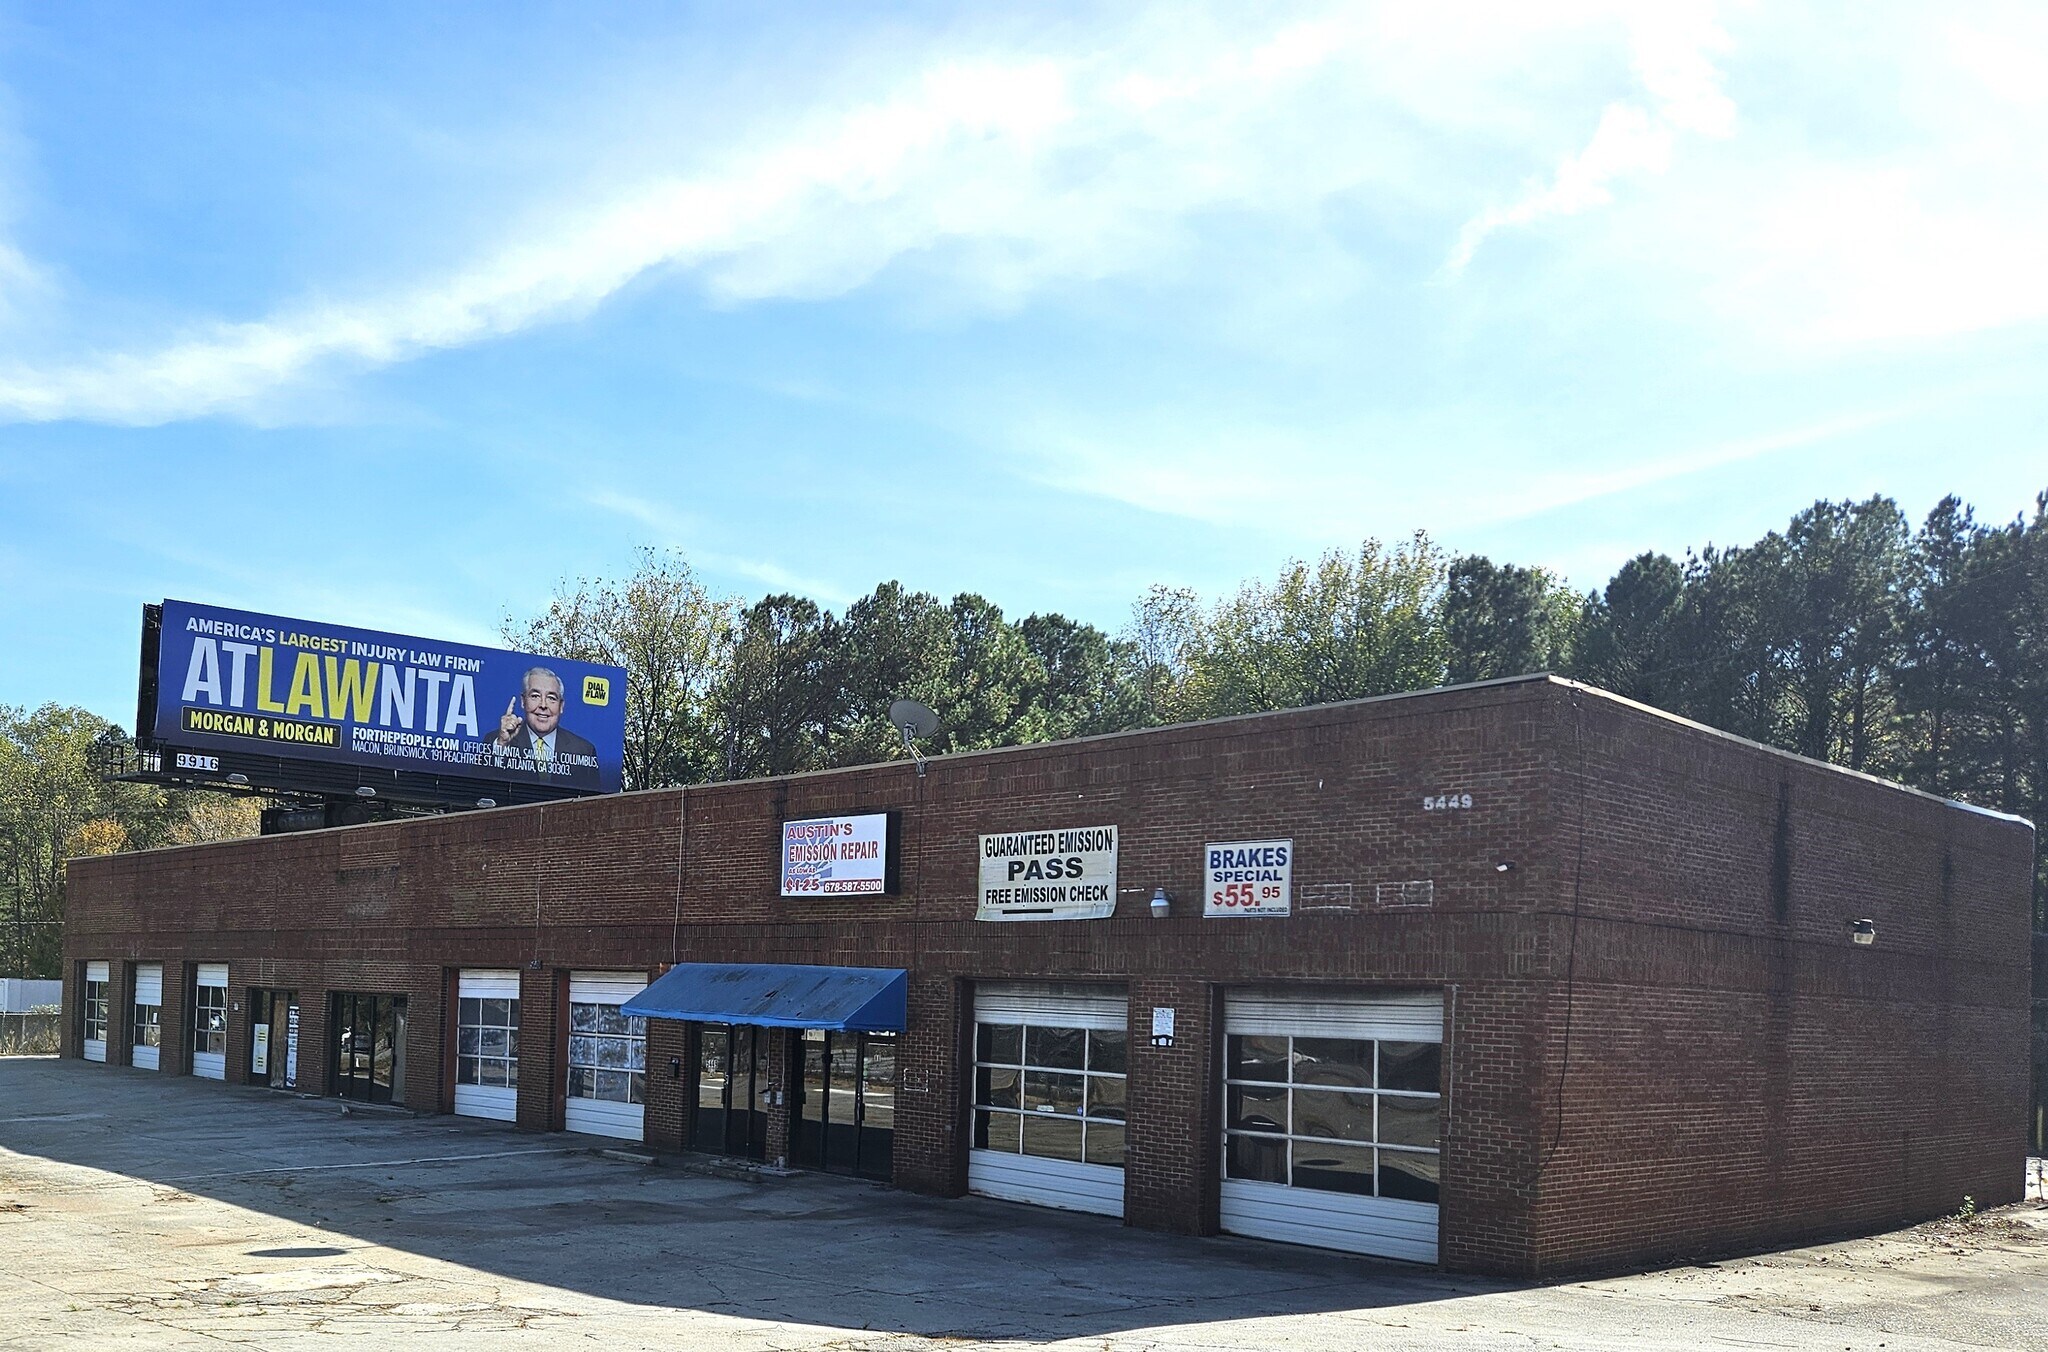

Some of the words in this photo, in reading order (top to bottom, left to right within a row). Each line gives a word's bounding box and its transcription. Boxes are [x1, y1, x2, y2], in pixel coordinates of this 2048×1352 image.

[186, 617, 276, 643] AMERICA'S
[279, 631, 348, 654] LARGEST
[352, 642, 407, 661] INJURY
[410, 651, 441, 667] LAW
[180, 636, 479, 737] ATLAWNTA
[585, 690, 606, 700] #LAW
[587, 682, 604, 692] DIAL
[190, 711, 254, 735] MORGAN
[258, 719, 269, 737] &
[273, 722, 334, 744] MORGAN
[352, 727, 459, 751] FORTHEPEOPLE.COM
[560, 753, 599, 769] COLUMBUS,
[352, 740, 382, 756] MACON,
[431, 749, 443, 761] 191
[443, 751, 482, 767] PEACHTREE
[494, 756, 506, 770] NE,
[507, 758, 536, 773] ATLANTA,
[538, 761, 548, 773] GA
[177, 753, 219, 770] 9916
[1423, 794, 1473, 811] 5449
[787, 823, 853, 839] AUSTIN'S
[789, 843, 837, 862] EMISSION
[841, 841, 878, 860] REPAIR
[985, 833, 1055, 858] GUARANTEED
[1058, 829, 1113, 853] EMISSION
[1210, 847, 1287, 869] BRAKES
[1008, 857, 1083, 881] PASS
[1213, 870, 1283, 882] SPECIAL
[824, 881, 882, 892] 678-587-5500
[986, 889, 1011, 904] FREE
[1014, 886, 1066, 903] EMISSION
[1070, 885, 1108, 901] CHECK
